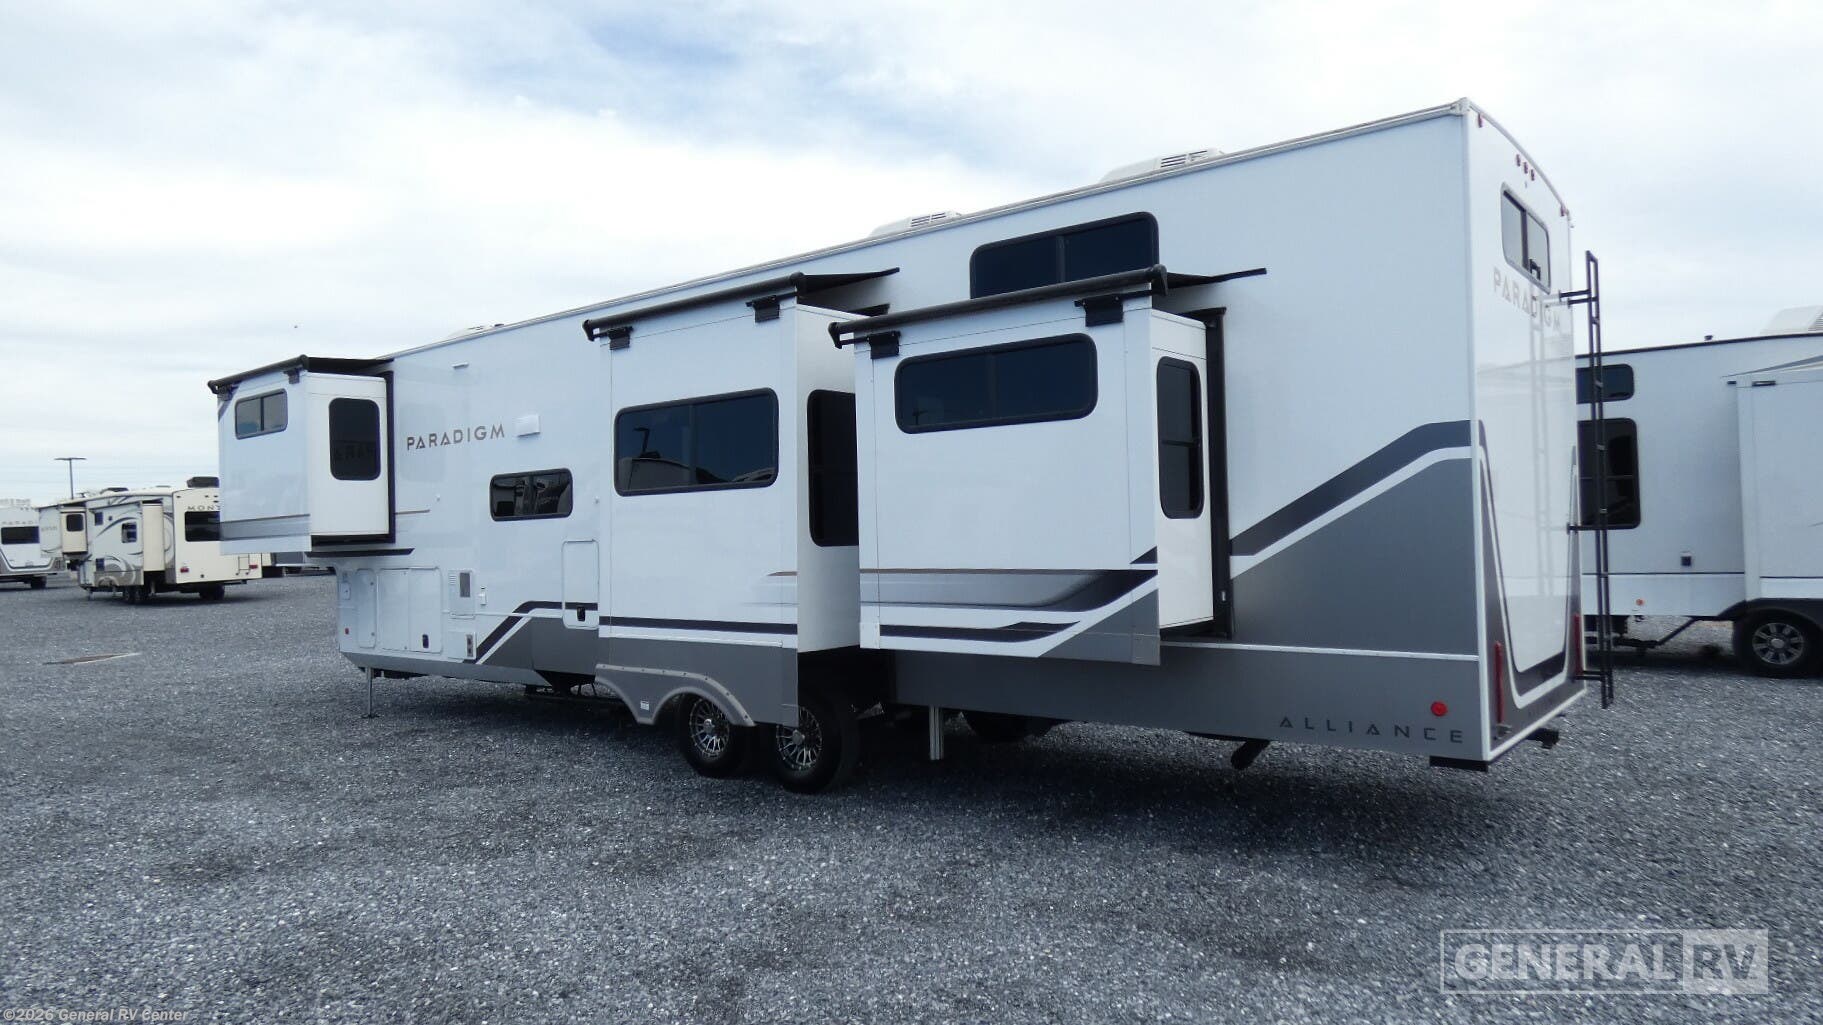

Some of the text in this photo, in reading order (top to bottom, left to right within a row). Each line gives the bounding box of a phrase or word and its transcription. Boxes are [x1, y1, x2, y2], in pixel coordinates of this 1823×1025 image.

[1492, 268, 1560, 328] PARADIGM
[406, 423, 504, 450] PARADIGM
[1279, 716, 1463, 743] ALLIANCE
